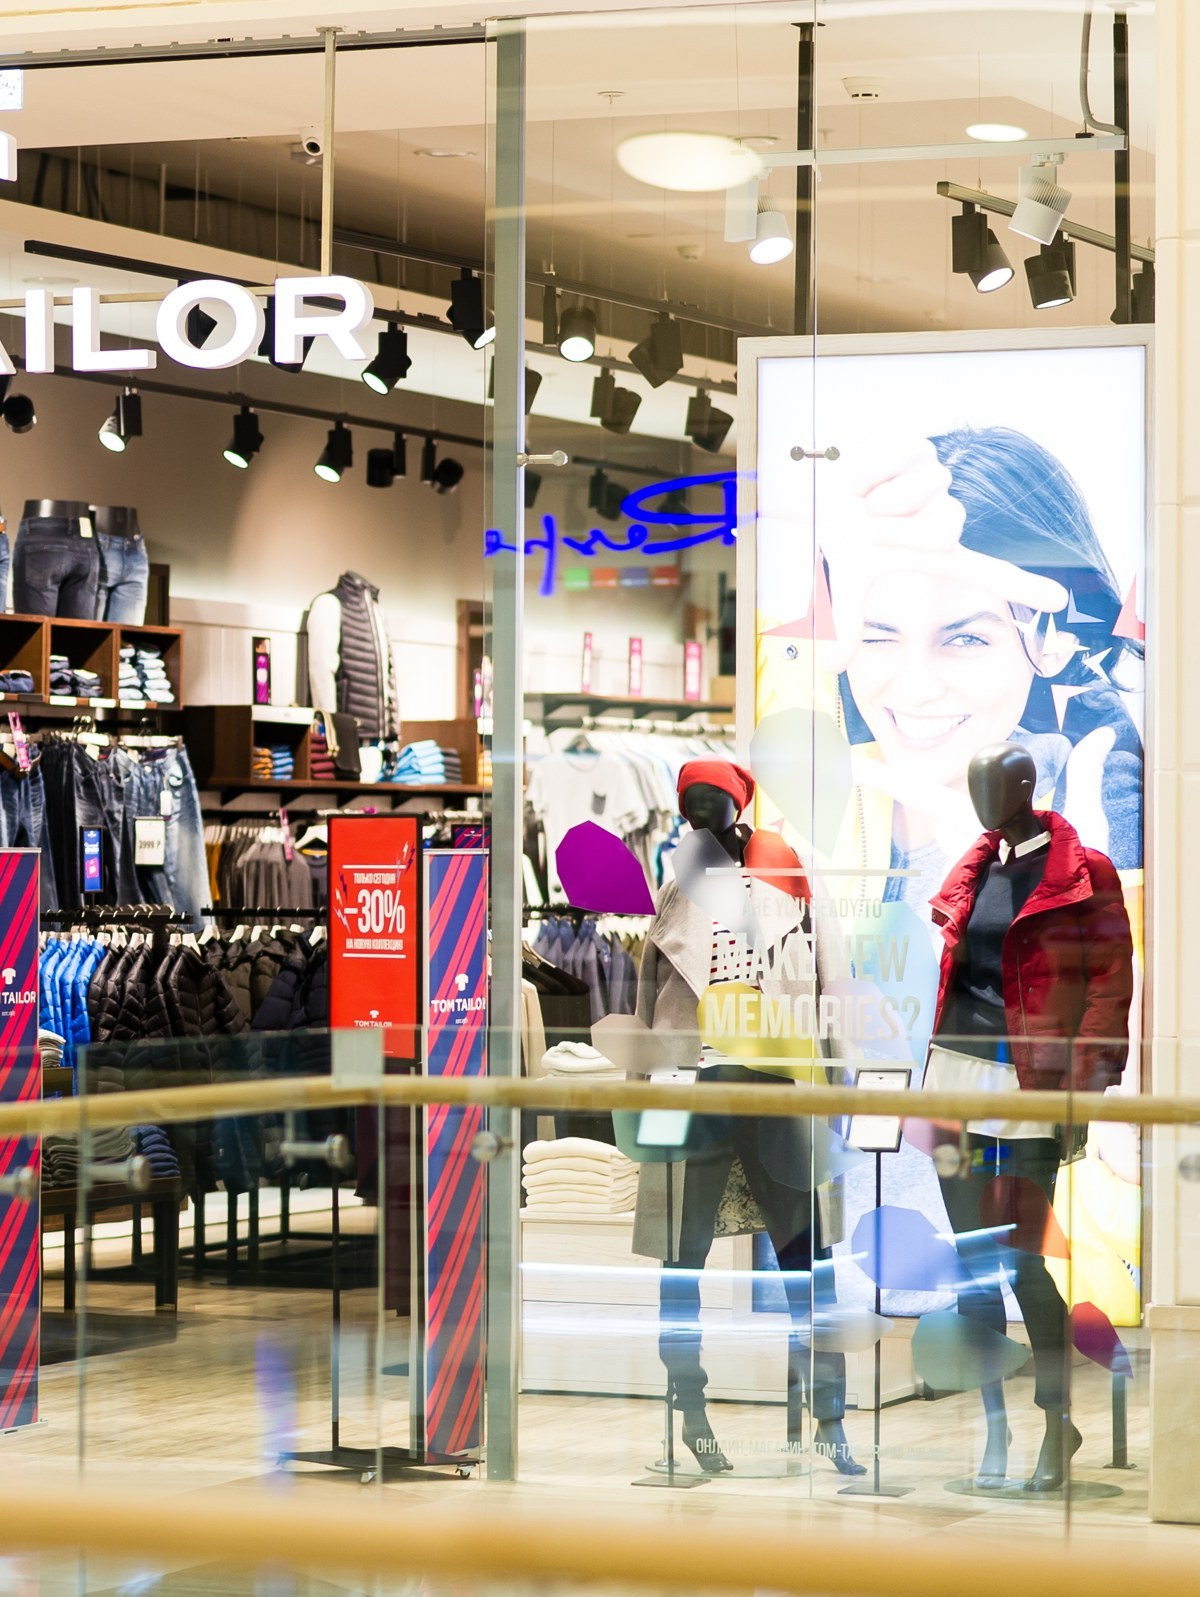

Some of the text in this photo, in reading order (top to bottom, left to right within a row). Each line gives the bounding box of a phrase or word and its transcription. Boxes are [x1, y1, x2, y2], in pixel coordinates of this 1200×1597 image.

[353, 872, 396, 886] ТОЛЬКО СЕГОДНЯ
[343, 888, 405, 934] -30%
[864, 899, 882, 918] TO
[345, 938, 403, 951] НА НОВУЮ КОЛЛЕКЦИЮ
[714, 932, 816, 981] MAKE
[1, 991, 36, 1004] TAILOR
[431, 999, 455, 1013] TOM
[702, 992, 921, 1040] MEMORIES?
[370, 1020, 392, 1028] TAILOR
